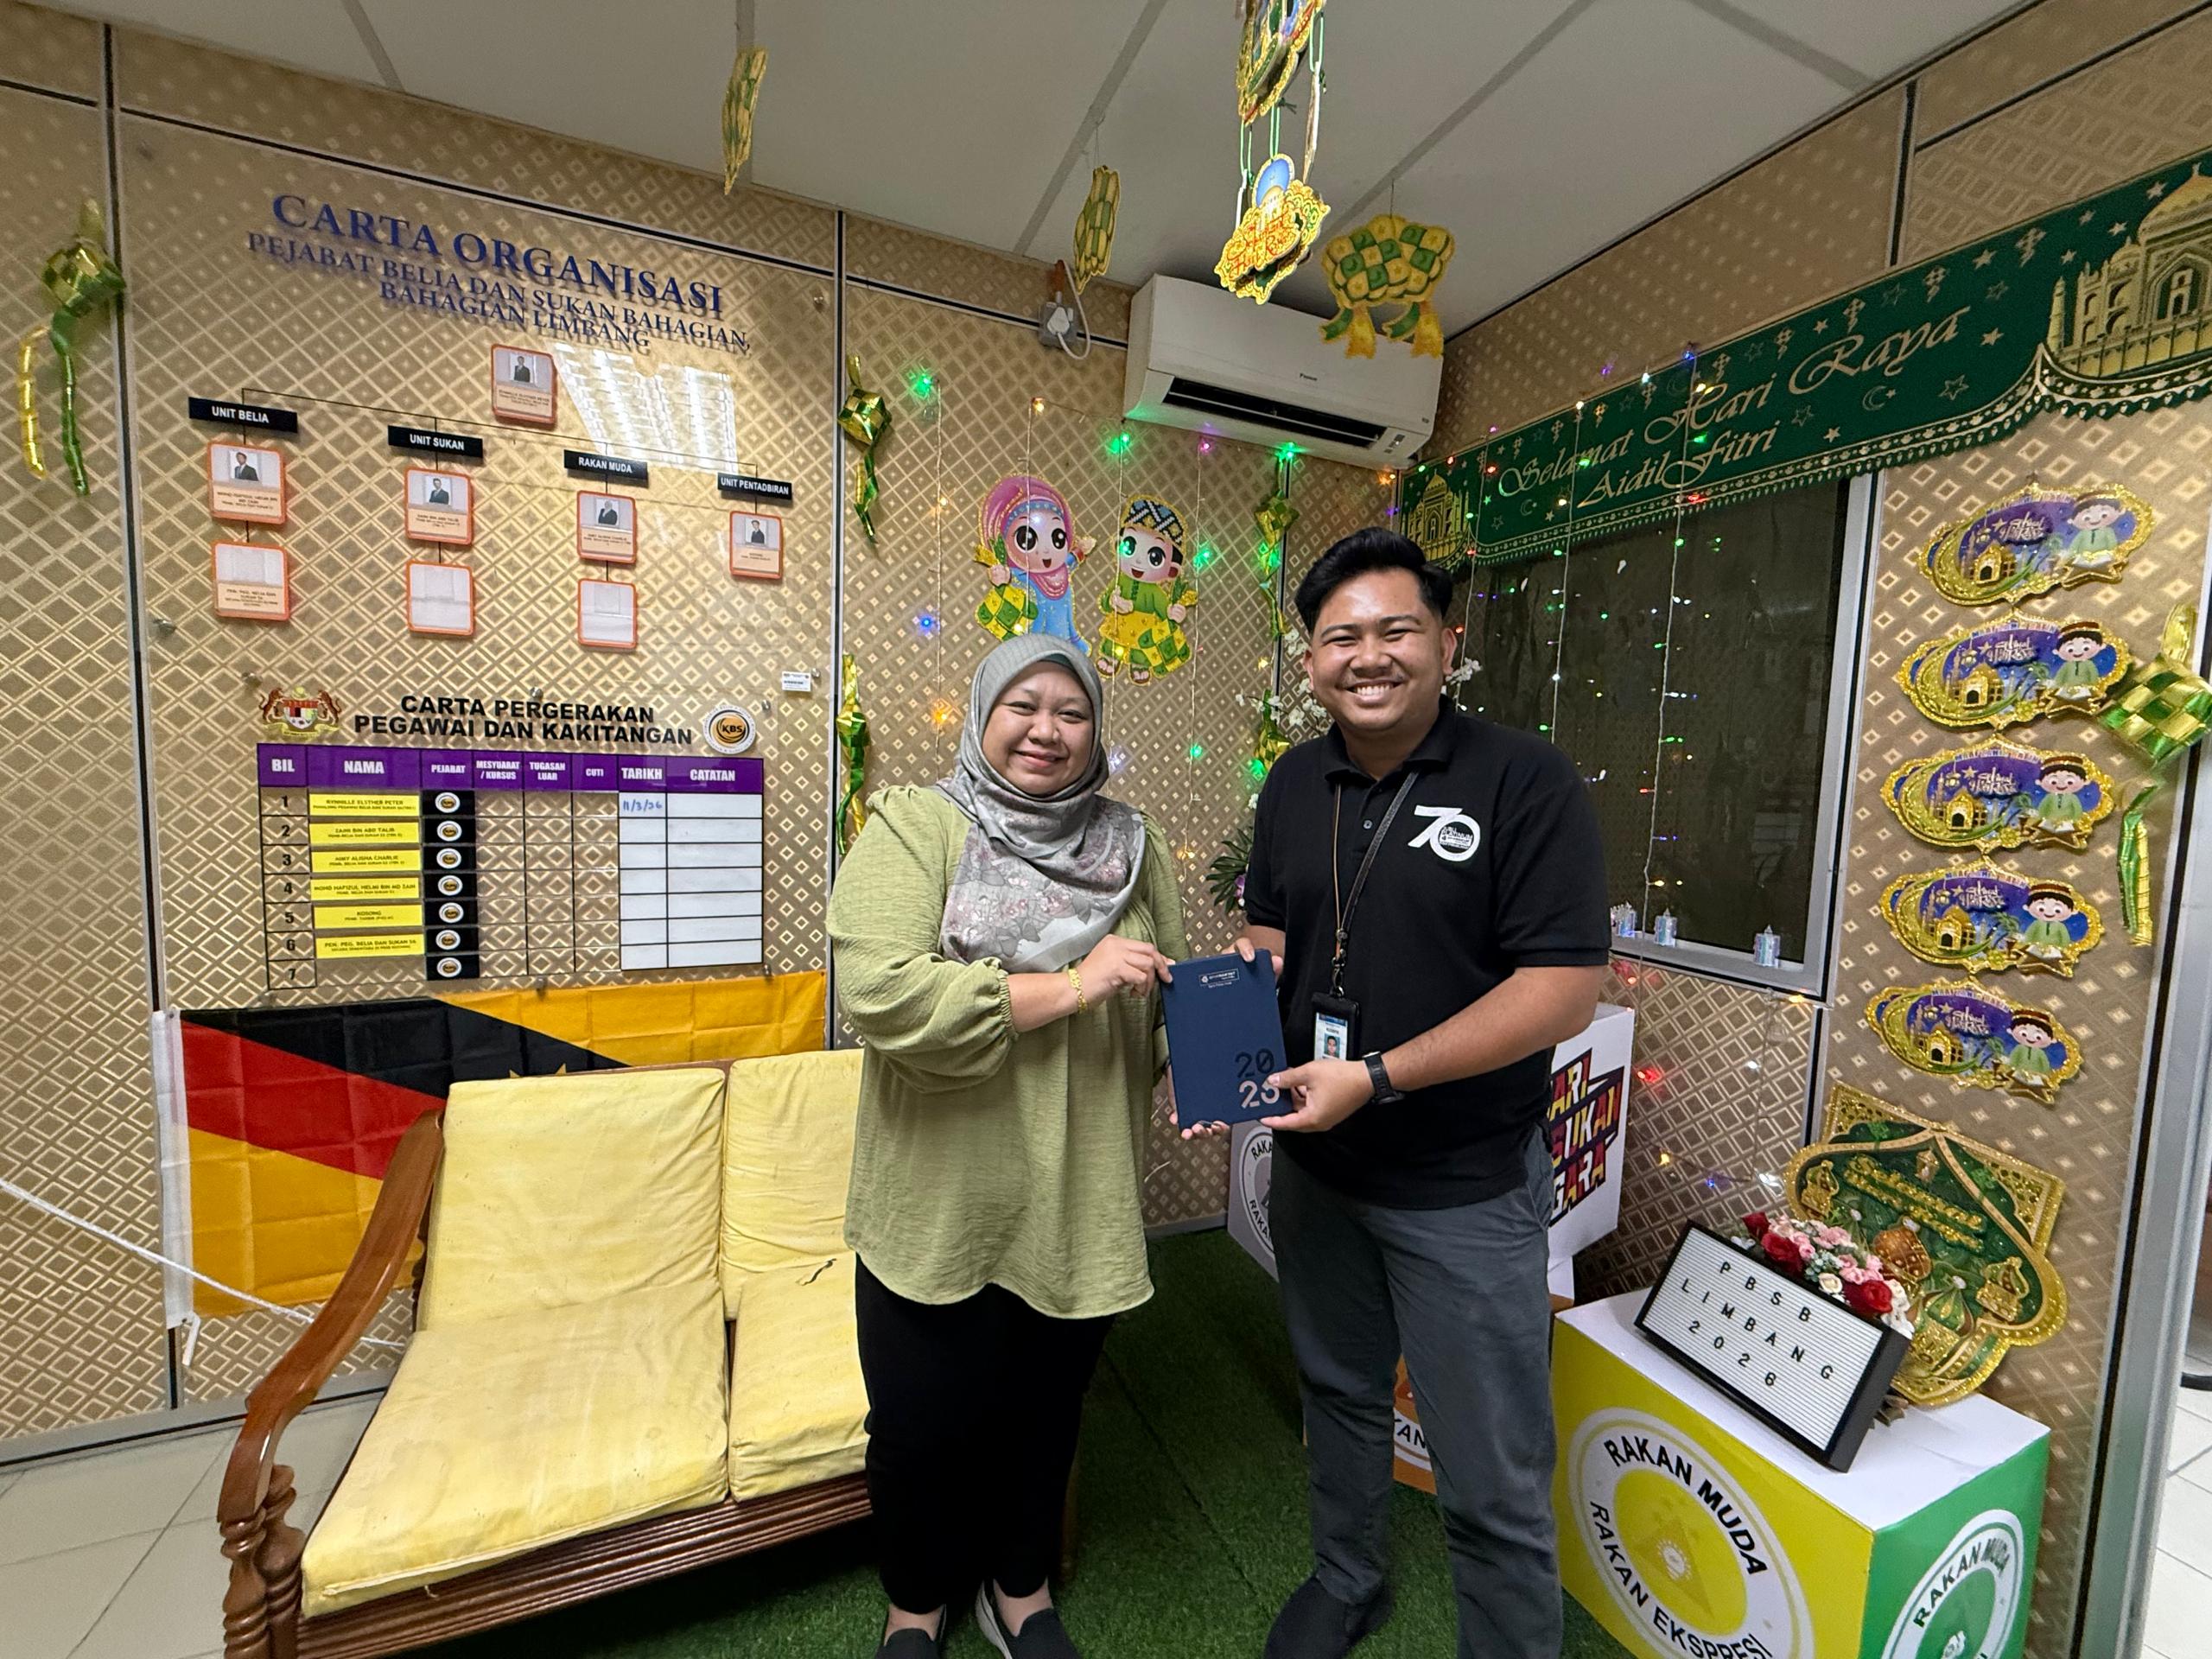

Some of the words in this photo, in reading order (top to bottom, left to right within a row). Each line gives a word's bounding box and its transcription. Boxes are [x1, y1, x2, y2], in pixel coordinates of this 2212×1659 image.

[273, 194, 442, 257] CARTA
[453, 232, 723, 313] ORGANISASI
[247, 232, 374, 272] PEJABAT
[383, 260, 462, 290] BELIA
[469, 277, 525, 302] DAN
[532, 289, 616, 321] SUKAN
[623, 307, 751, 351] BAHAGIAN,
[379, 281, 525, 324] BAHAGIAN
[533, 309, 650, 347] LIMBANG
[1497, 429, 1635, 497] Selamat
[1644, 372, 1777, 445] Hari
[1788, 305, 1971, 395] Raya
[211, 405, 237, 419] UNIT
[238, 410, 270, 424] BELIA
[410, 433, 432, 446] UNIT
[433, 437, 465, 450] SUKAN
[578, 456, 607, 470] RAKAN
[608, 461, 632, 474] MUDA
[721, 477, 737, 488] UNIT
[739, 480, 789, 495] PENTADBIRAN
[401, 696, 486, 716] CARTA
[494, 700, 654, 723] PERGERAKAN
[354, 715, 474, 737] PEGAWAI
[484, 721, 533, 739] DAN
[542, 723, 692, 745] KAKITANGAN
[722, 724, 742, 734] KBS
[271, 759, 295, 772] BIL
[344, 760, 385, 774] NAMA
[431, 764, 466, 773] PEJABAT
[476, 760, 520, 770] MESYUARAT
[530, 761, 566, 771] TUGASAN
[586, 768, 604, 777] CUTI
[621, 767, 663, 779] TARIKH
[486, 771, 517, 779] KURSUS
[537, 772, 558, 780] LUAR
[690, 769, 735, 781] CATATAN
[282, 796, 288, 808] 1
[282, 825, 290, 837] 2
[1408, 804, 1481, 862] 70
[283, 854, 291, 866] 3
[283, 882, 293, 894] 4
[285, 912, 294, 924] 5
[286, 940, 296, 951] 6
[289, 969, 296, 980] 7
[1235, 1048, 1275, 1078] 20
[1238, 1080, 1281, 1109] 25
[1548, 1055, 1590, 1122] ARI
[1550, 1142, 1605, 1221] GARA
[1249, 1199, 1271, 1242] RAKA
[1604, 1435, 1693, 1486] RAKAN
[1697, 1479, 1768, 1575] MUDA
[1590, 1501, 1649, 1608] RAKAN
[1653, 1606, 1773, 1659] EKSPRESI
[1913, 1541, 1981, 1628] RAKAN
